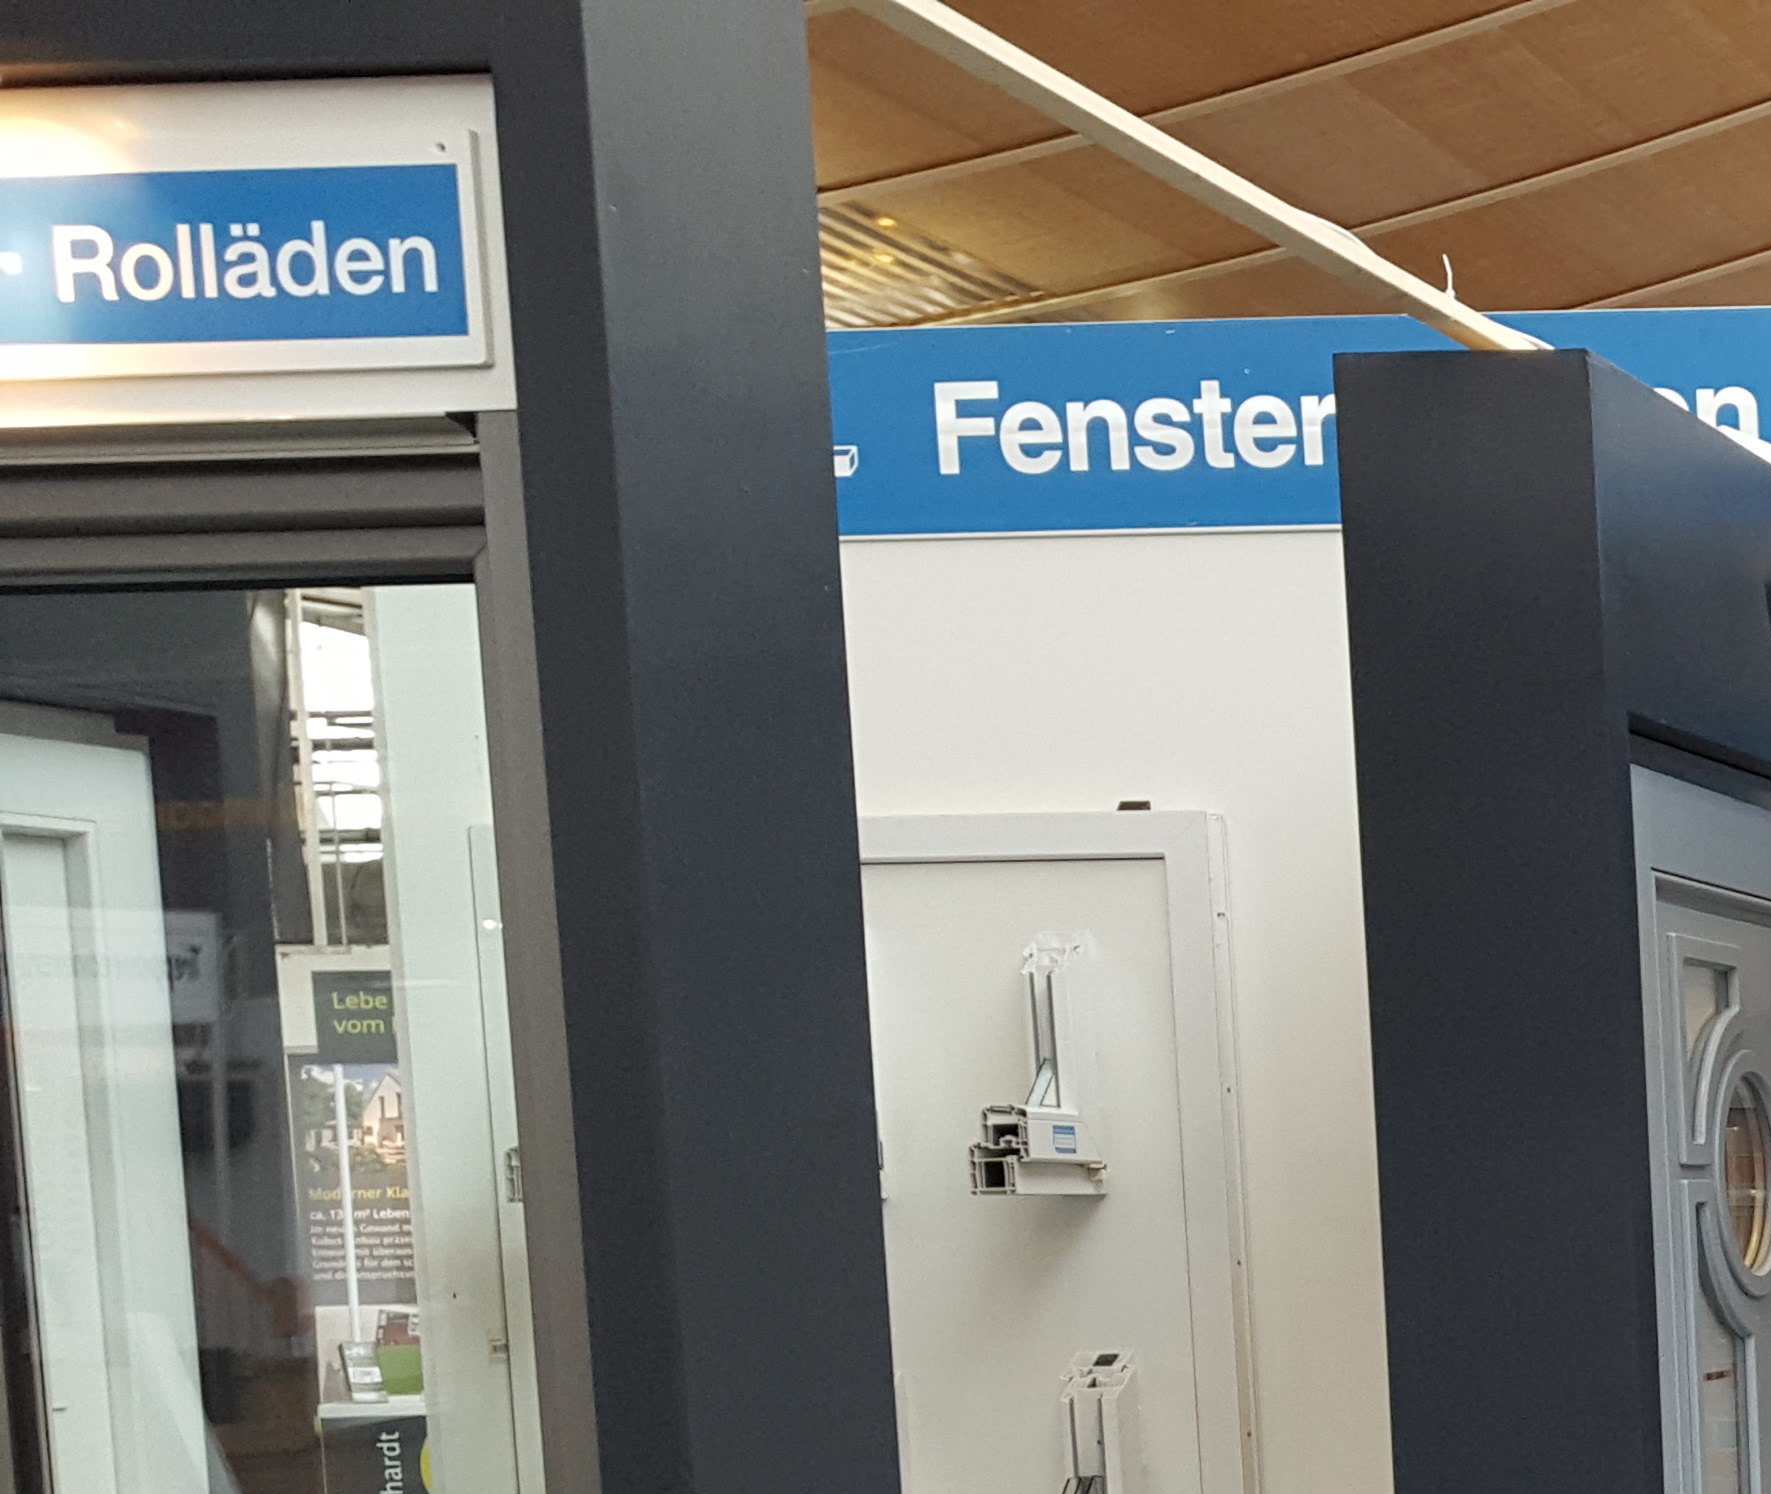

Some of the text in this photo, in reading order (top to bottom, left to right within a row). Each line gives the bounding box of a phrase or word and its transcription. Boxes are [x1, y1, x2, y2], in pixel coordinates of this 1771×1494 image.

[52, 221, 439, 304] Rolläden
[934, 380, 1337, 476] Fenster
[334, 1018, 384, 1034] vom
[309, 1187, 383, 1200] Modrner
